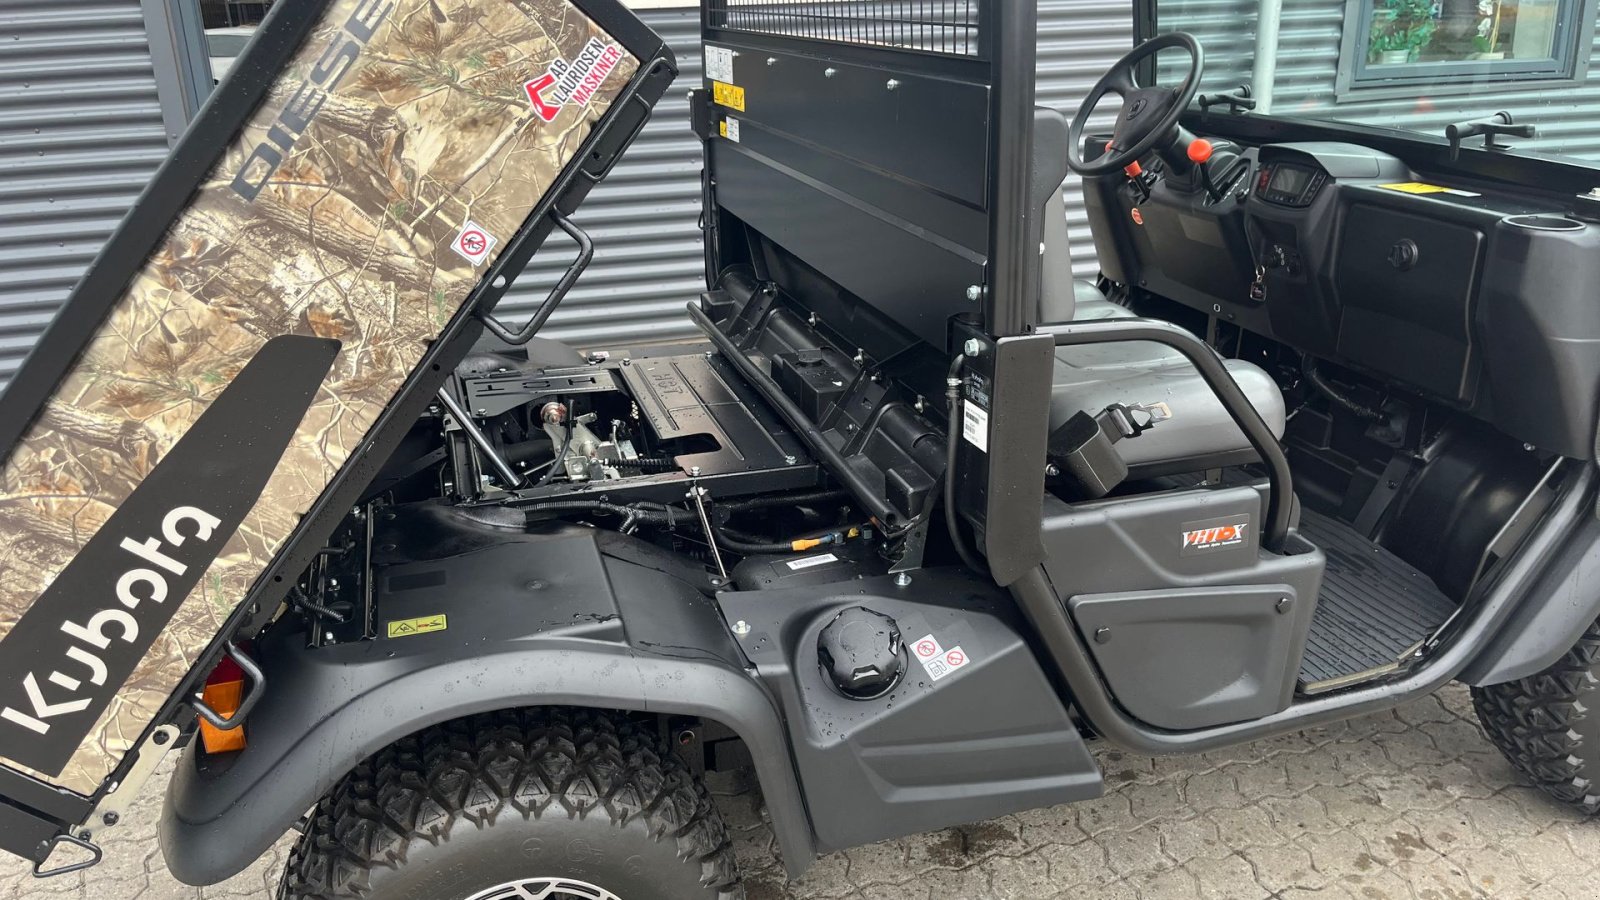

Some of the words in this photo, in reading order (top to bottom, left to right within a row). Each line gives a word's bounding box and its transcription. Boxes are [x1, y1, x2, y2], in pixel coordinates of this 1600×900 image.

[549, 59, 569, 79] AB
[553, 39, 605, 103] LAURIDSEN
[572, 46, 621, 105] MASKINER
[0, 505, 222, 735] Kubota
